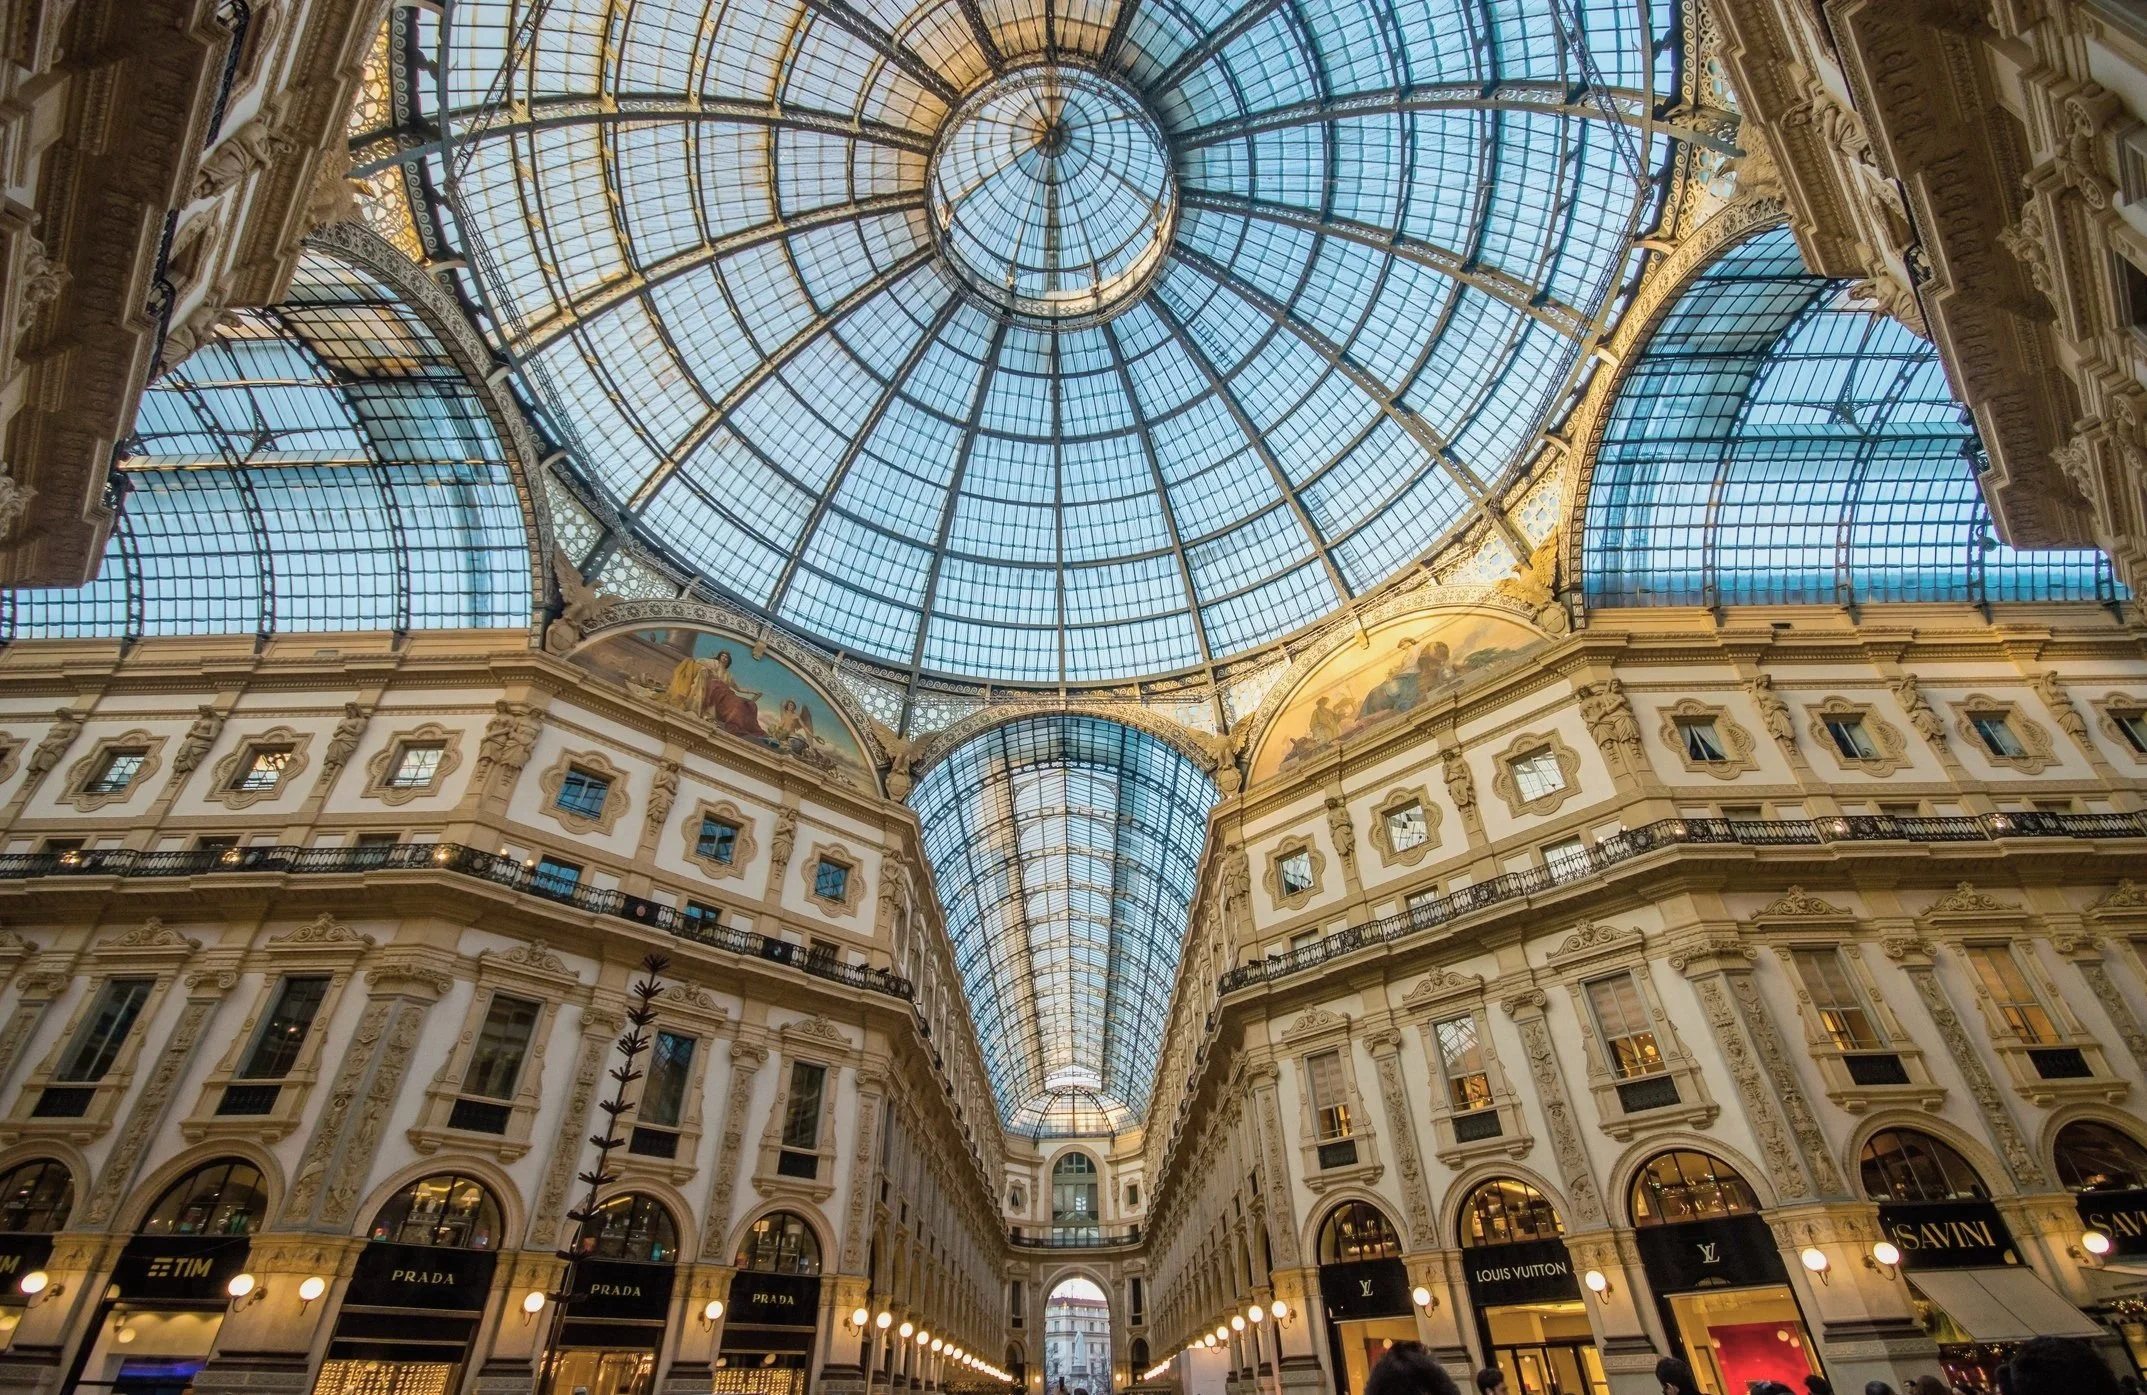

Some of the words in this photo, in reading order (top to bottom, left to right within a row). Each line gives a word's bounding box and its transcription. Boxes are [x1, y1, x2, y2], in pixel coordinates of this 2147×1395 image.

[1896, 1220, 1996, 1250] SAVINI
[173, 1257, 214, 1278] TIM
[1476, 1267, 1511, 1283] LOUIS
[1512, 1261, 1568, 1280] VUITTON
[391, 1269, 455, 1285] PRADA
[590, 1283, 641, 1297] PRADA
[752, 1293, 795, 1305] PRADA
